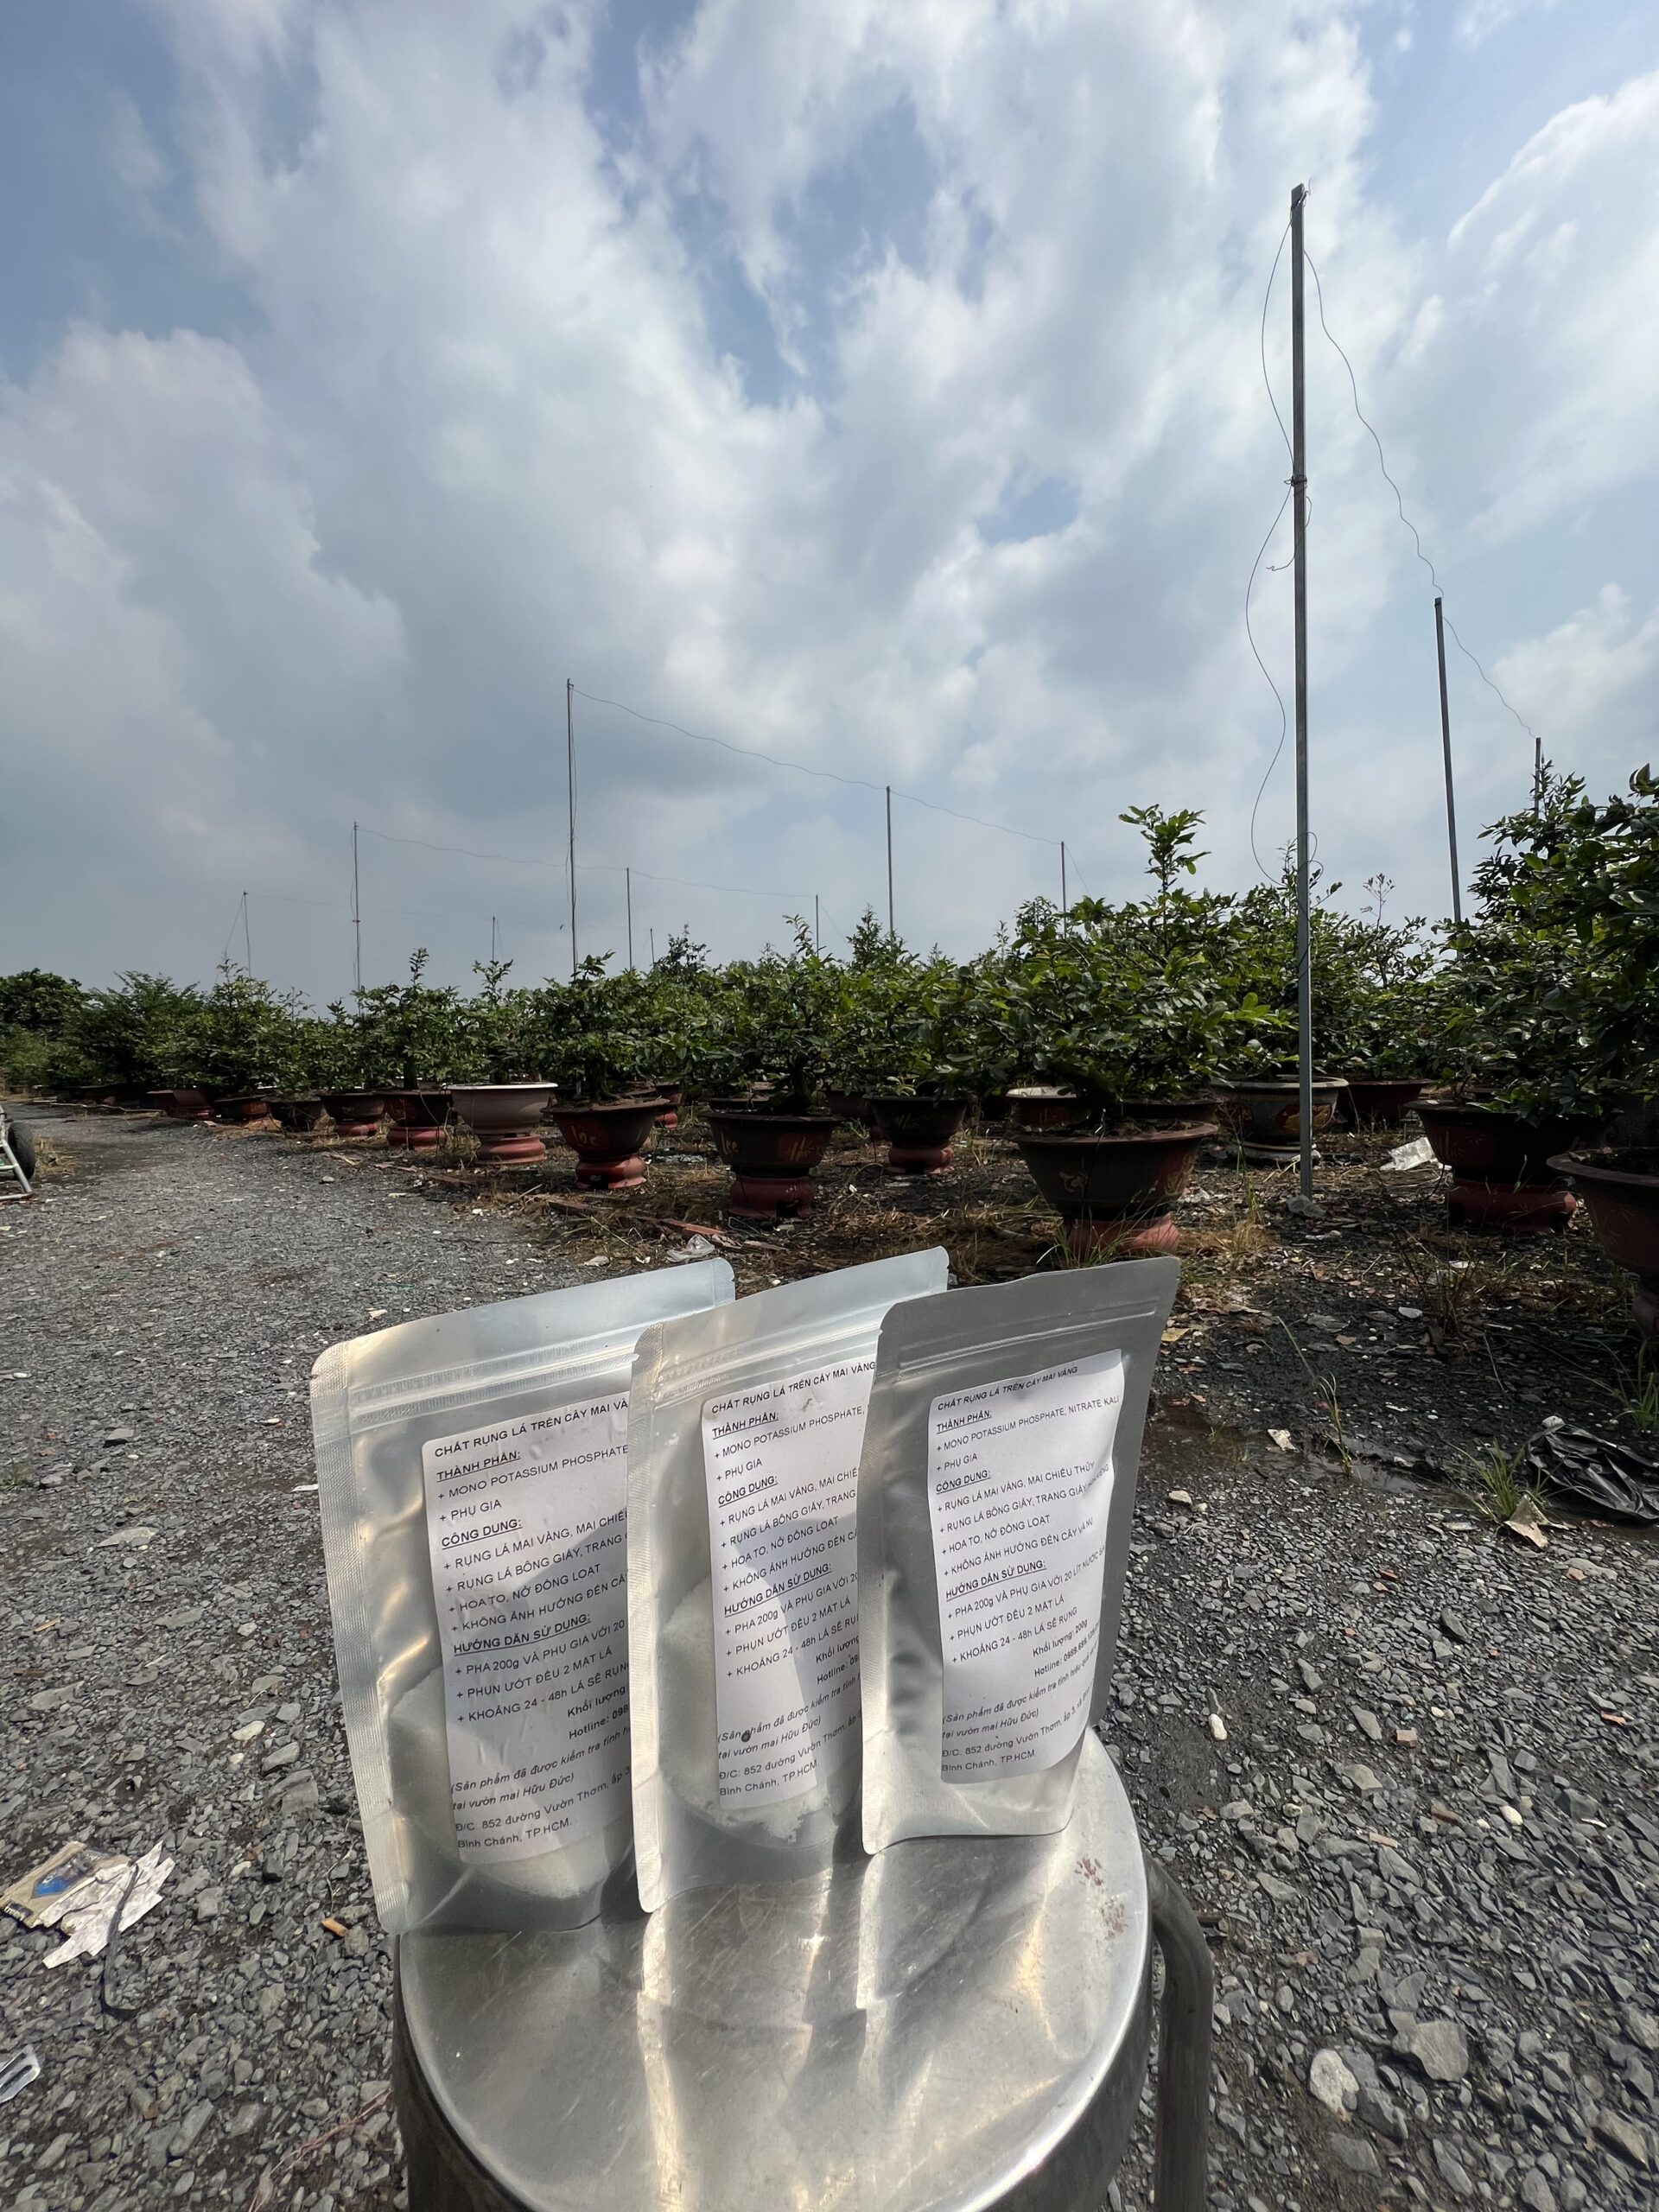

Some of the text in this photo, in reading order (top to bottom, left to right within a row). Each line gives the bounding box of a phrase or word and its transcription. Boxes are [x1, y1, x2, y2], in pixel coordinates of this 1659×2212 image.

[742, 1391, 770, 1406] RỤNG
[833, 1368, 848, 1378] MAI
[851, 1362, 874, 1374] VÀNG
[963, 1391, 987, 1403] RỤNG
[1042, 1373, 1056, 1382] MAI
[1058, 1366, 1077, 1377] VÀNG
[474, 1430, 507, 1447] RỤNG
[512, 1422, 527, 1436] LÁ
[591, 1404, 609, 1415] MAI
[712, 1420, 747, 1438] THÀNH
[722, 1440, 751, 1457] MONO
[753, 1421, 806, 1446] POTASSIUM
[937, 1417, 966, 1432] THÀNH
[944, 1435, 969, 1451] MONO
[971, 1421, 1016, 1441] POTASSIUM
[1068, 1399, 1102, 1414] NITRATE
[1103, 1395, 1119, 1406] KALI
[436, 1461, 482, 1483] THÀNH
[449, 1480, 487, 1497] MONO
[491, 1461, 558, 1486] POTASSIUM
[725, 1465, 743, 1479] PHỤ
[944, 1458, 961, 1471] PHỤ
[451, 1499, 502, 1520] PHỤ GIA
[945, 1496, 969, 1511] RỤNG
[984, 1488, 998, 1498] MAI
[1001, 1479, 1026, 1493] VÀNG,
[1027, 1474, 1043, 1485] MAI
[455, 1521, 595, 1568] RỤNG LÁ MAI VÀNG, MAI
[731, 1553, 752, 1568] HOA
[753, 1546, 768, 1558] TO,
[771, 1536, 785, 1550] NỞ
[951, 1556, 982, 1574] KHÔNG
[1078, 1523, 1085, 1534] VÀ
[460, 1563, 601, 1611] HOA TO, NỞ ĐỒNG LOẠT
[1001, 1566, 1014, 1579] SỬ
[462, 1615, 506, 1630] KHÔNG
[510, 1609, 535, 1622] ẢNH
[539, 1592, 583, 1616] HƯỞNG
[734, 1619, 756, 1634] PHA
[757, 1610, 778, 1625] 200g
[780, 1599, 793, 1613] VÀ
[795, 1592, 813, 1607] PHỤ
[454, 1638, 500, 1653] HƯỚNG
[533, 1625, 554, 1641] SỬ
[467, 1619, 627, 1675] PHA 200g VÀ PHỤ GIA VỚI 20
[563, 1665, 569, 1675] 2
[599, 1645, 613, 1660] LÁ
[468, 1703, 520, 1721] KHOẢNG
[524, 1698, 537, 1709] 24
[548, 1689, 567, 1700] 48h
[571, 1680, 584, 1694] LÁ
[773, 1715, 785, 1727] đã
[831, 1688, 841, 1697] tra
[569, 1717, 608, 1739] Hotline:
[761, 1737, 779, 1750] mai
[513, 1768, 526, 1779] đã
[531, 1761, 557, 1775] được
[588, 1743, 601, 1754] tra
[603, 1732, 620, 1746] tính
[453, 1801, 466, 1810] tại
[469, 1796, 496, 1808] vườn
[499, 1789, 519, 1802] mai
[523, 1783, 545, 1796] Hữu
[482, 1818, 501, 1829] 852
[505, 1810, 540, 1825] đường
[543, 1798, 574, 1814] Vườn
[484, 1834, 522, 1847] Chánh,
